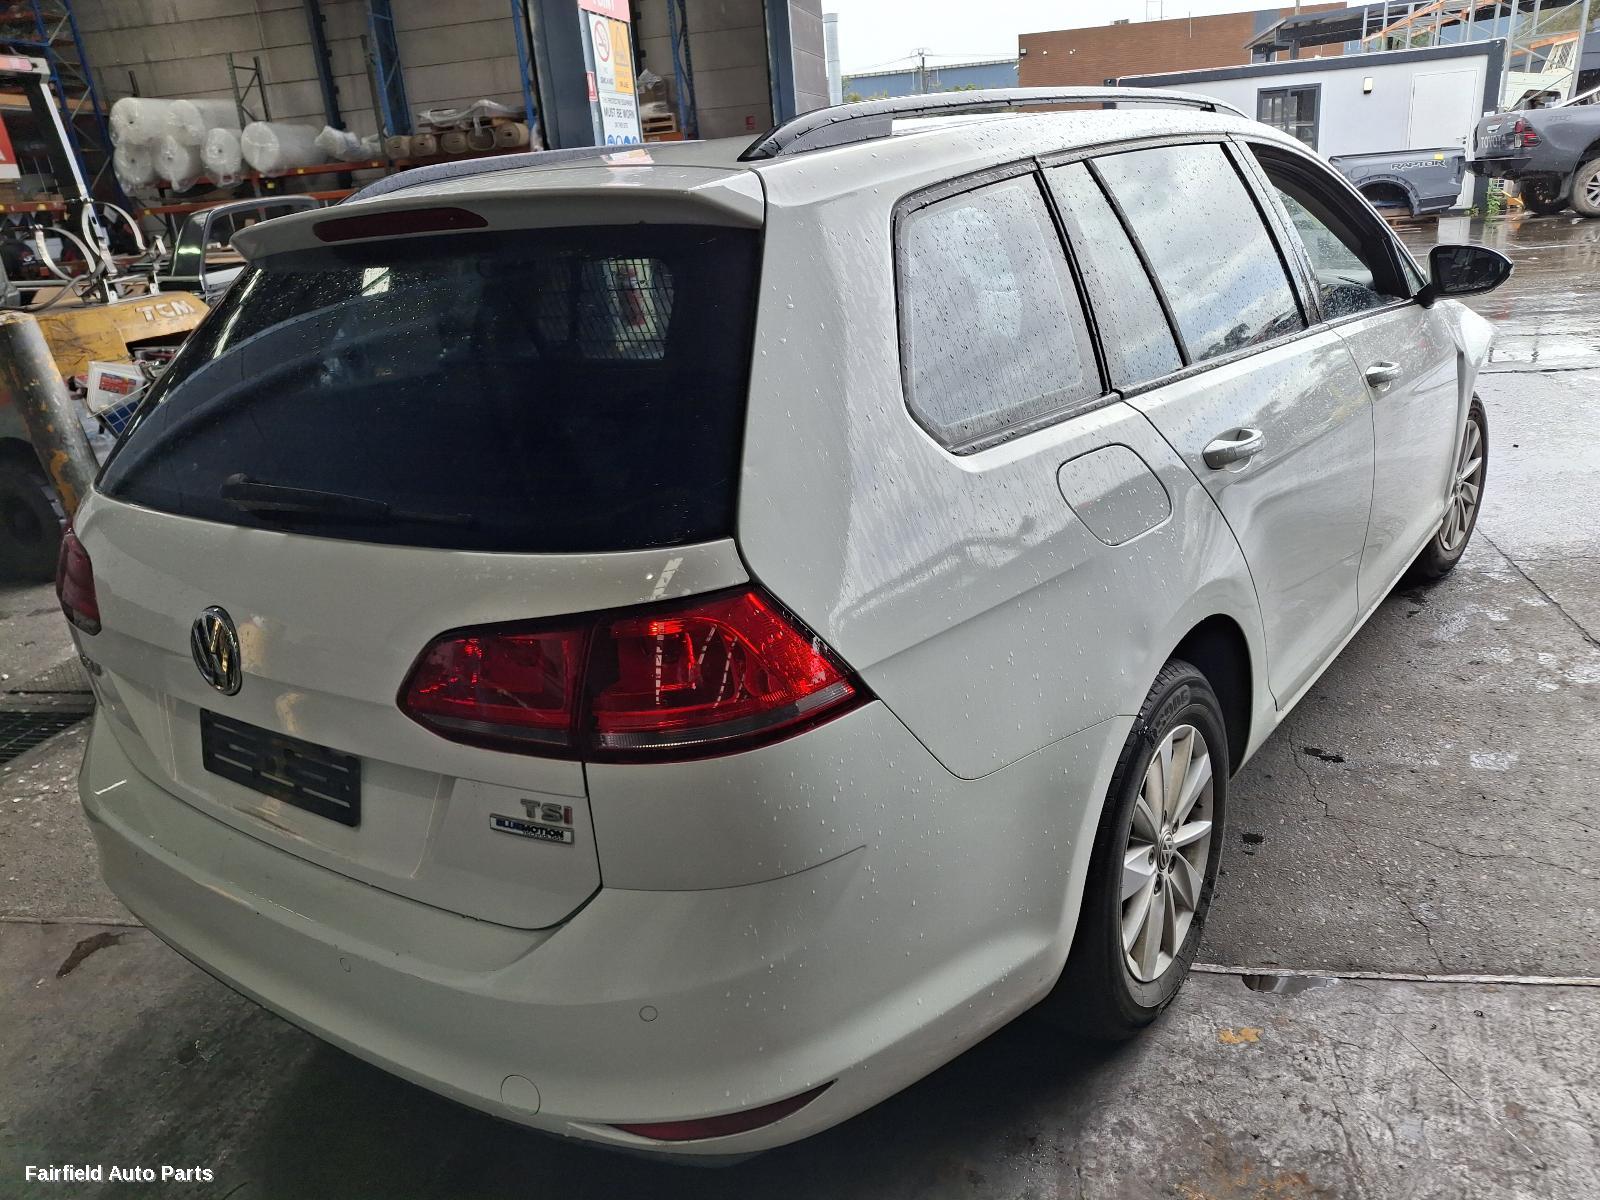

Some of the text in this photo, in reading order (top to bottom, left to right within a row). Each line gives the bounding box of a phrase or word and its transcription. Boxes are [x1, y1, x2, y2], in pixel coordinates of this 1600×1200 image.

[1480, 134, 1507, 149] TOYOTA
[1391, 160, 1447, 171] RAPTOR
[135, 301, 195, 321] TCM
